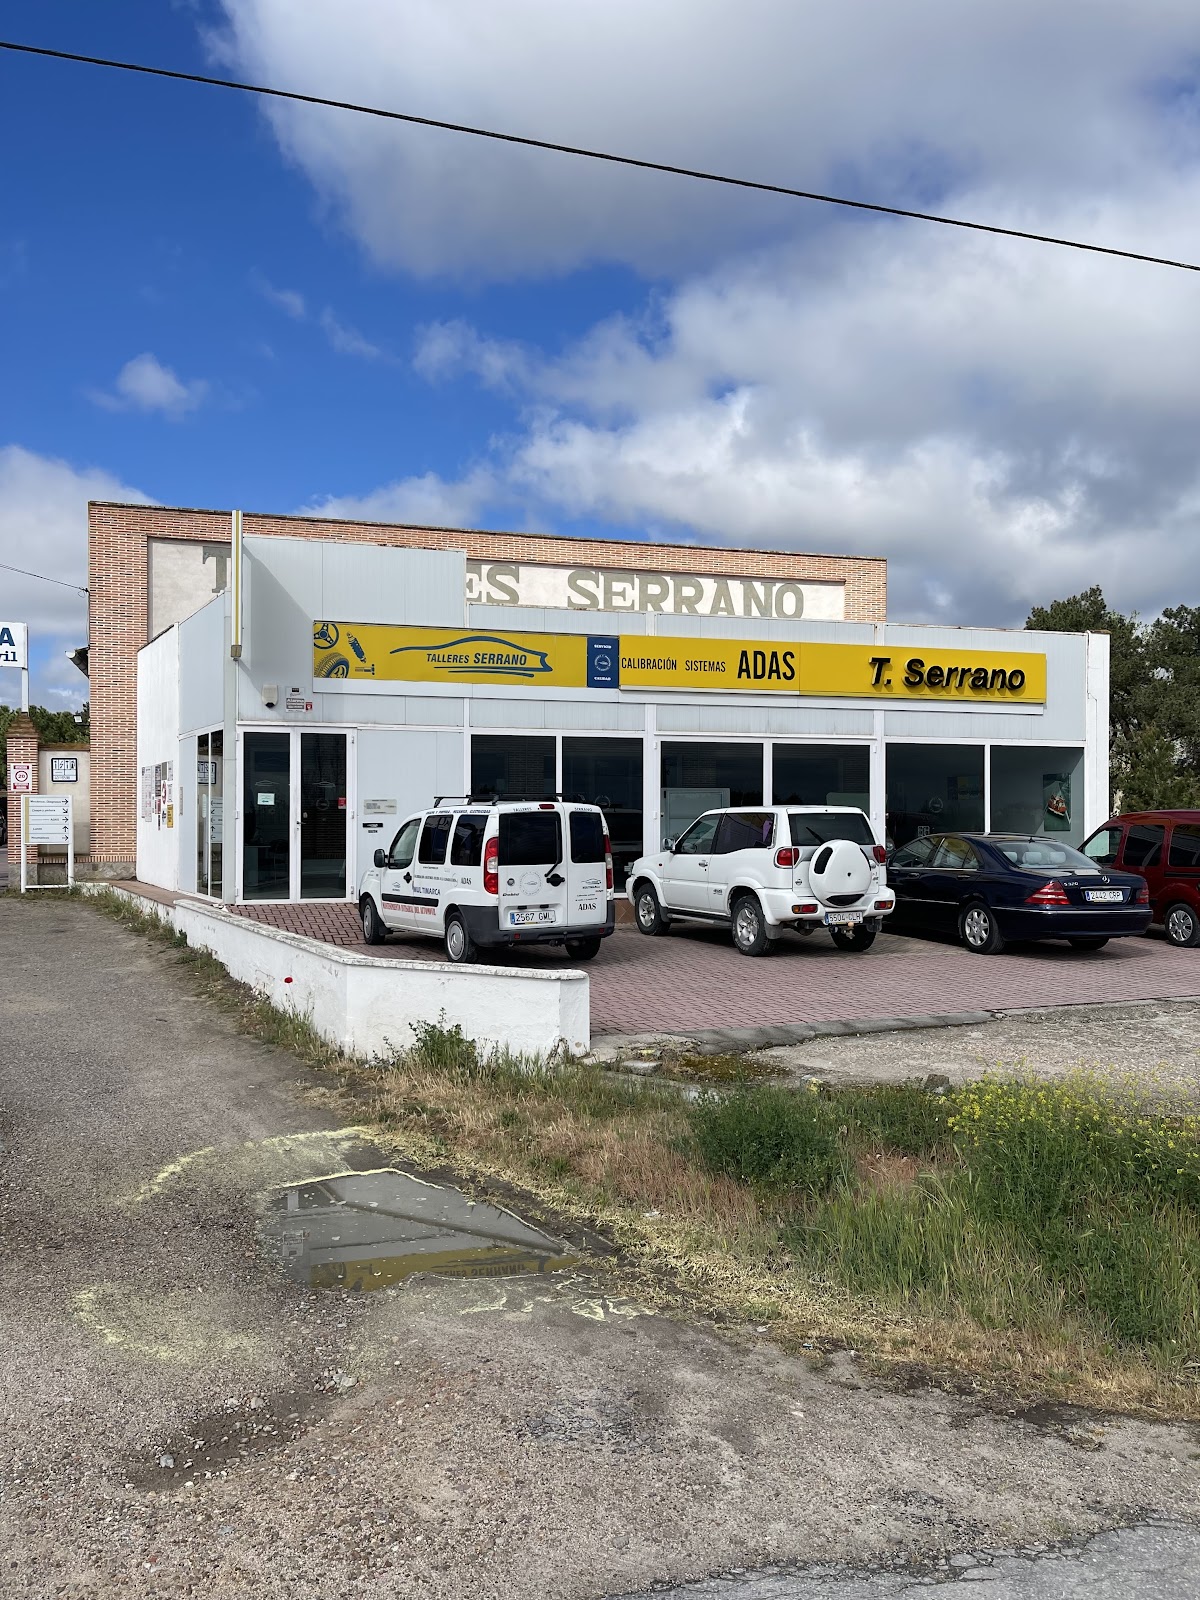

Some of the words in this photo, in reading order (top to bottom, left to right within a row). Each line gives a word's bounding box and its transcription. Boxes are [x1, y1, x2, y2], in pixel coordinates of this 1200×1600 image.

[567, 569, 804, 618] SERRANO
[427, 653, 469, 663] TALLERES
[473, 653, 527, 665] SERRANO
[621, 657, 677, 670] CALIBRACIÓN
[685, 660, 726, 672] SISTEMAS
[737, 650, 795, 680] ADAS
[869, 657, 892, 686] T.
[903, 658, 1026, 690] Serrano
[516, 912, 535, 922] 2567
[578, 903, 597, 911] ADAS
